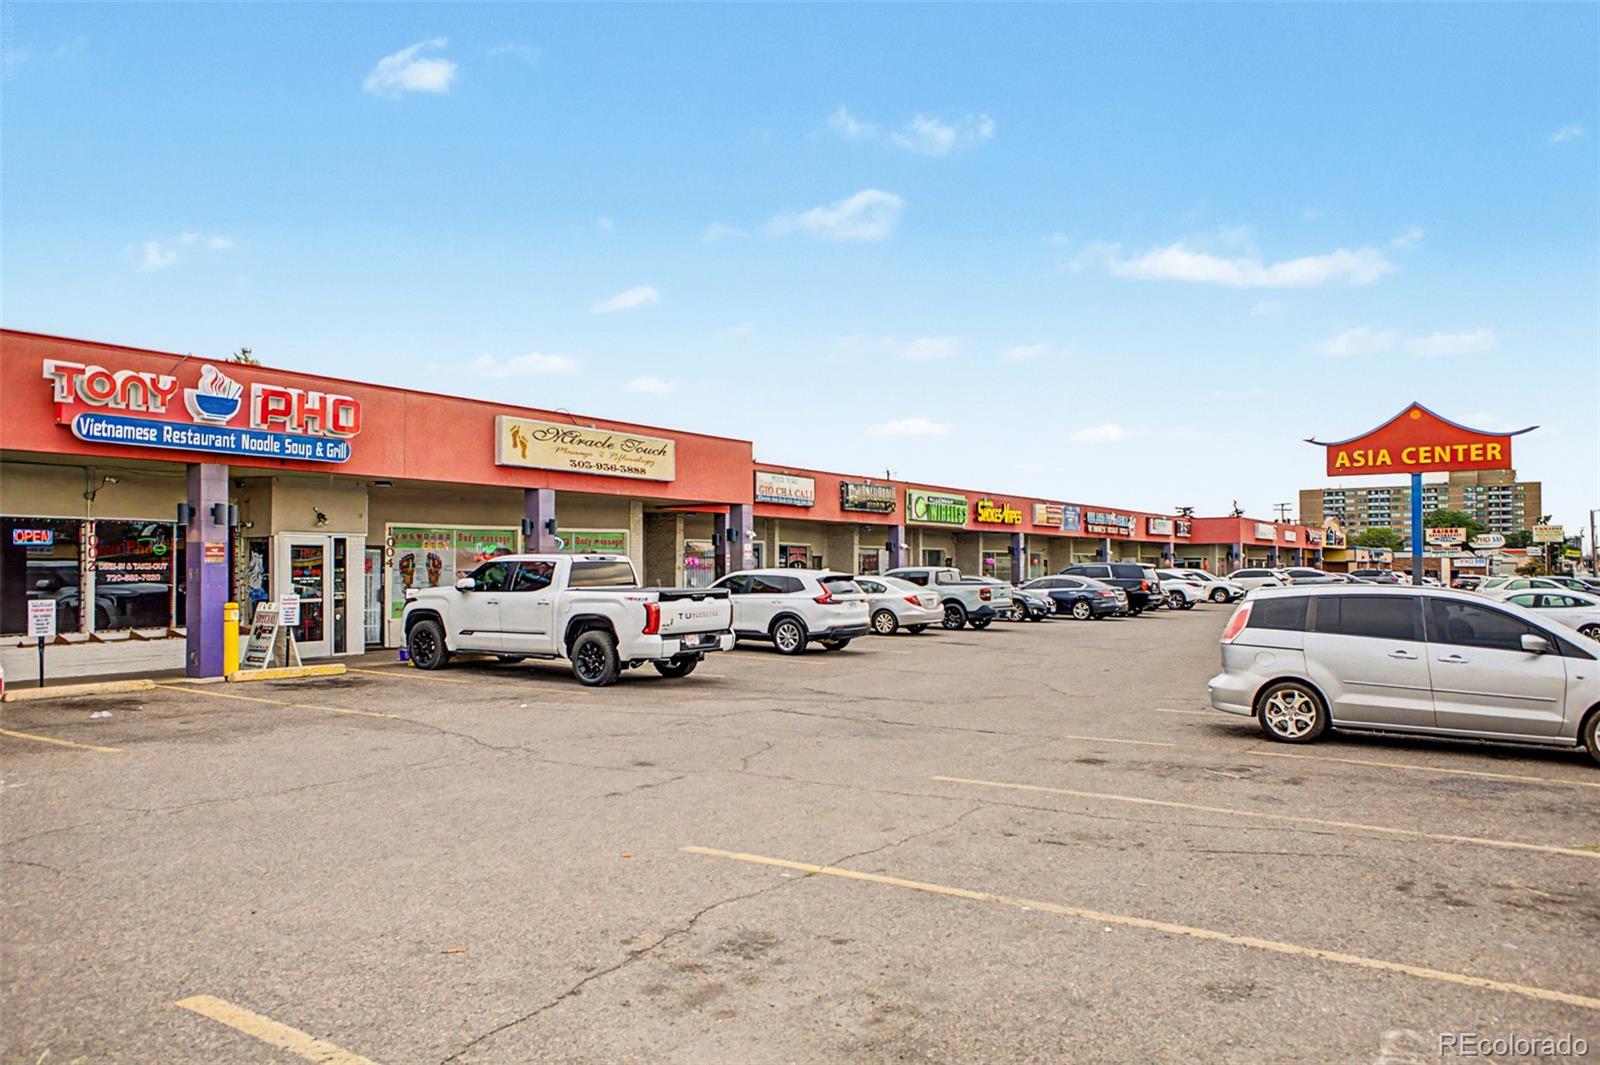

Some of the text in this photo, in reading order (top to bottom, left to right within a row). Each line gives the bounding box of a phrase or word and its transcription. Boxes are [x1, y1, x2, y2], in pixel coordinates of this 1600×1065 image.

[43, 359, 361, 438] TONY PHO
[79, 416, 348, 459] Vietnamese Restaurant Noodle Soup & Grill
[532, 427, 669, 457] Miracle Touch
[1335, 443, 1502, 468] ASIA CENTER
[15, 531, 50, 542] OPEN
